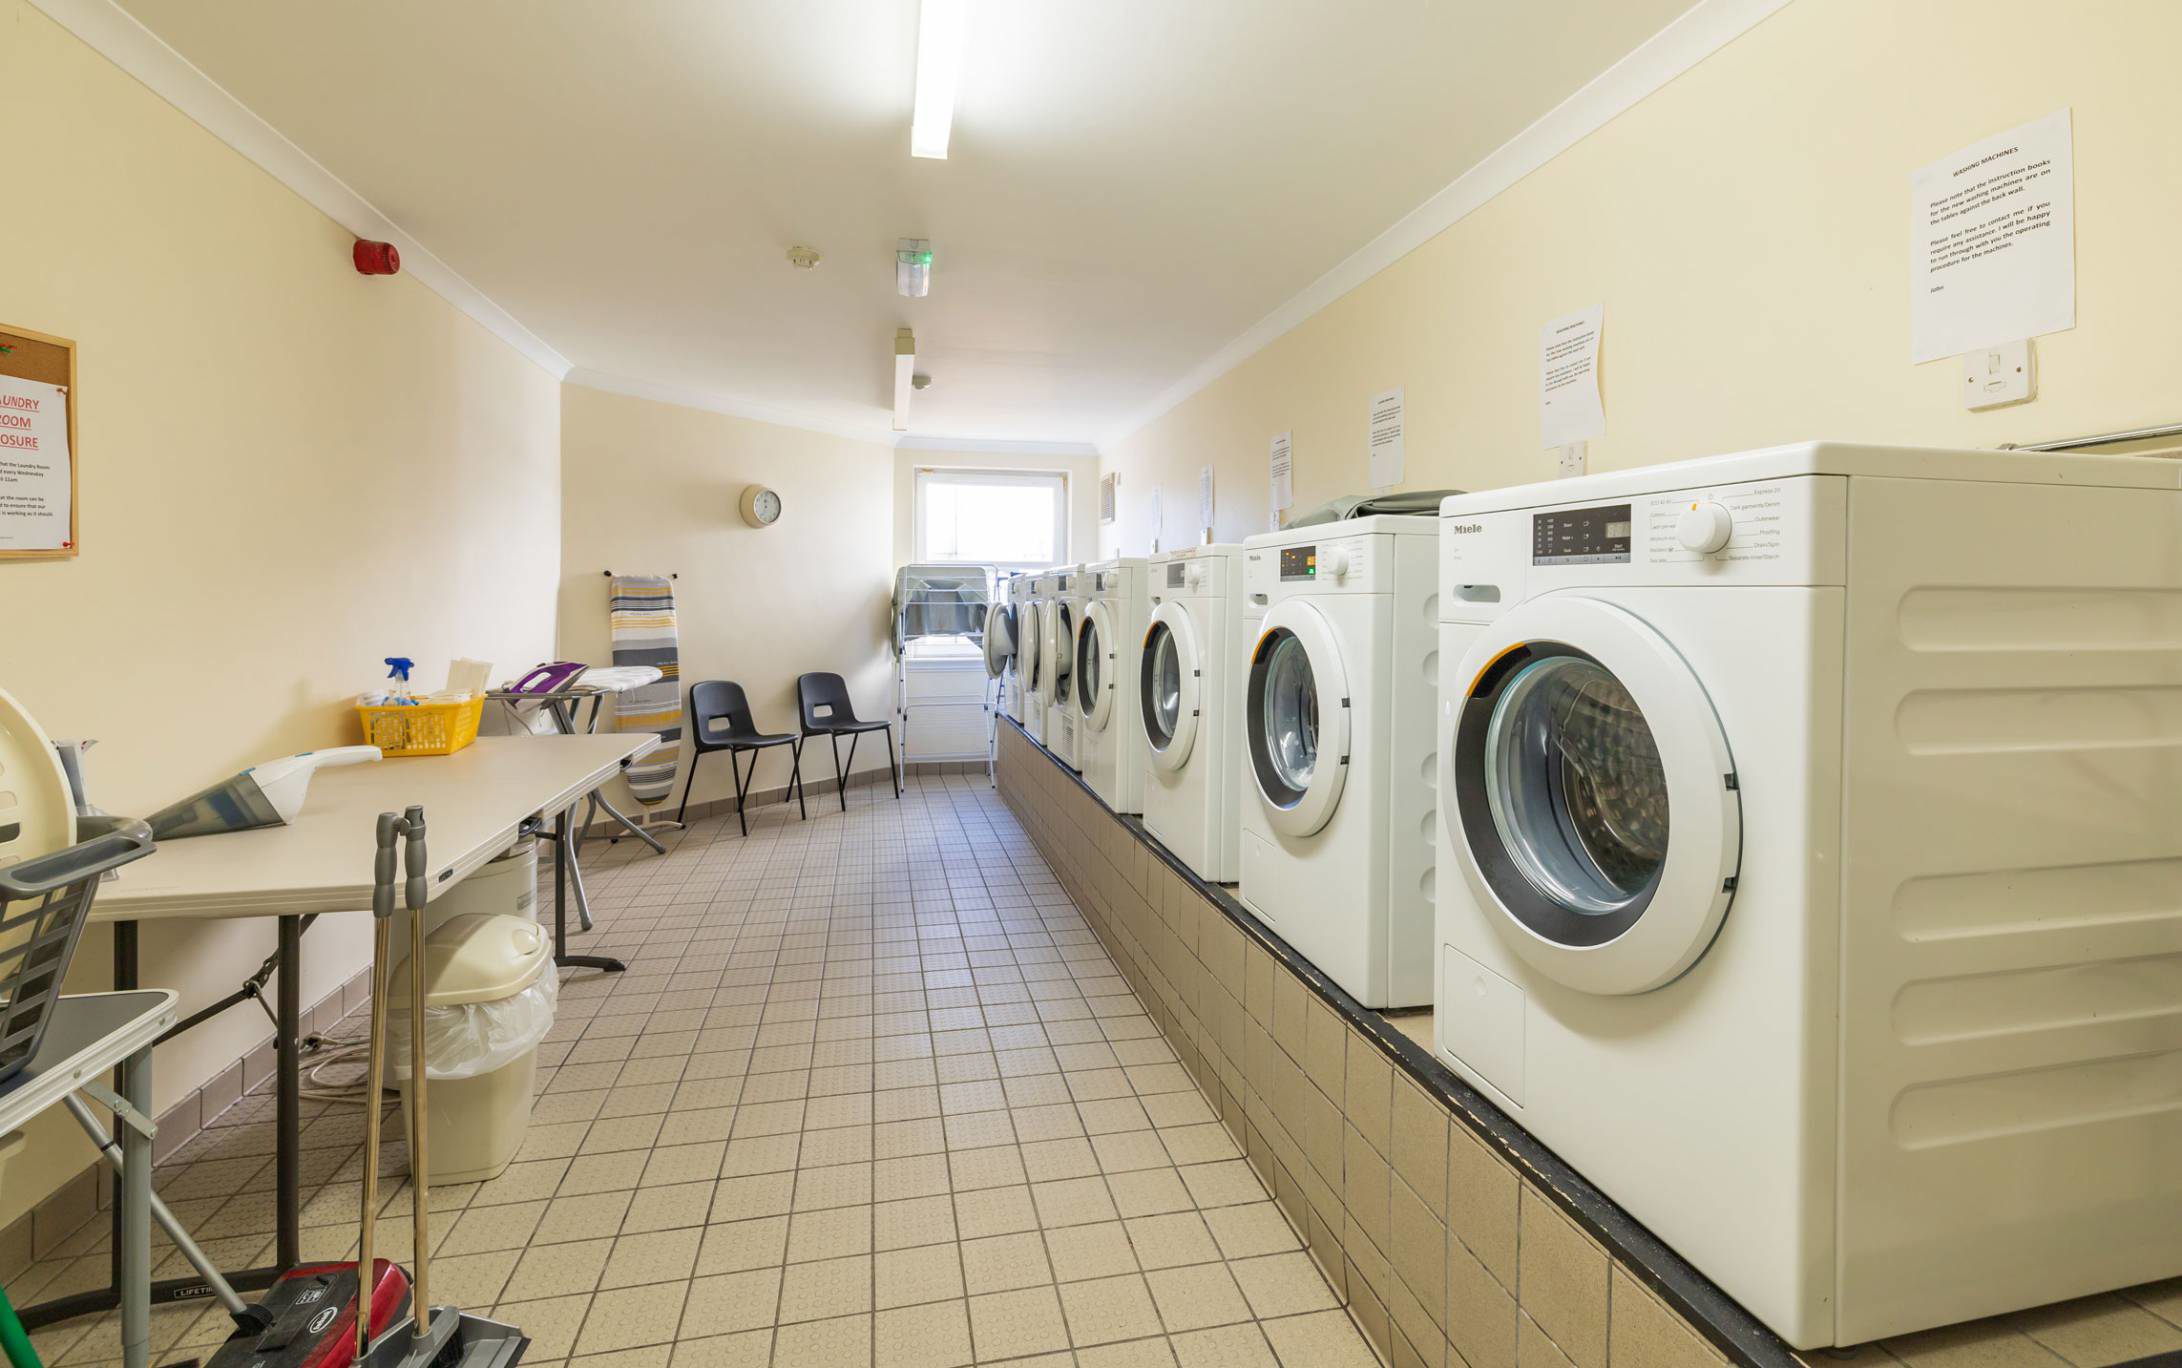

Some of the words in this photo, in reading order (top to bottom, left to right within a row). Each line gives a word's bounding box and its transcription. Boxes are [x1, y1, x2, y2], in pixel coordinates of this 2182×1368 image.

[1952, 161, 1980, 177] WASHING
[1981, 146, 2019, 164] MACHINES
[1930, 198, 1948, 208] Please
[1949, 192, 1963, 201] note
[1964, 186, 1976, 195] that
[1987, 167, 2026, 184] instruction
[2027, 159, 2051, 171] books
[1951, 201, 1965, 209] new
[1966, 190, 1989, 203] washing
[1990, 178, 2023, 193] machines
[2025, 173, 2038, 181] are
[1940, 212, 1959, 221] tables
[1960, 202, 1981, 215] against
[1991, 192, 2006, 202] back
[1930, 237, 1949, 246] Please
[1950, 230, 1963, 239] feel
[1964, 226, 1977, 234] free
[1988, 213, 2011, 226] contact
[2013, 209, 2025, 217] me
[2036, 201, 2051, 210] you
[1930, 244, 1951, 255] require
[2002, 221, 2014, 230] will
[2026, 210, 2051, 221] happy
[1949, 245, 1974, 258] through
[1975, 239, 1989, 249] with
[1990, 236, 2002, 244] you
[2002, 231, 2014, 239] the
[2014, 220, 2051, 235] operating
[1930, 259, 1960, 273] procedure
[0, 394, 39, 409] UNDRY
[0, 414, 31, 428] OOM
[0, 433, 39, 449] OSURE
[1454, 524, 1483, 535] Miele
